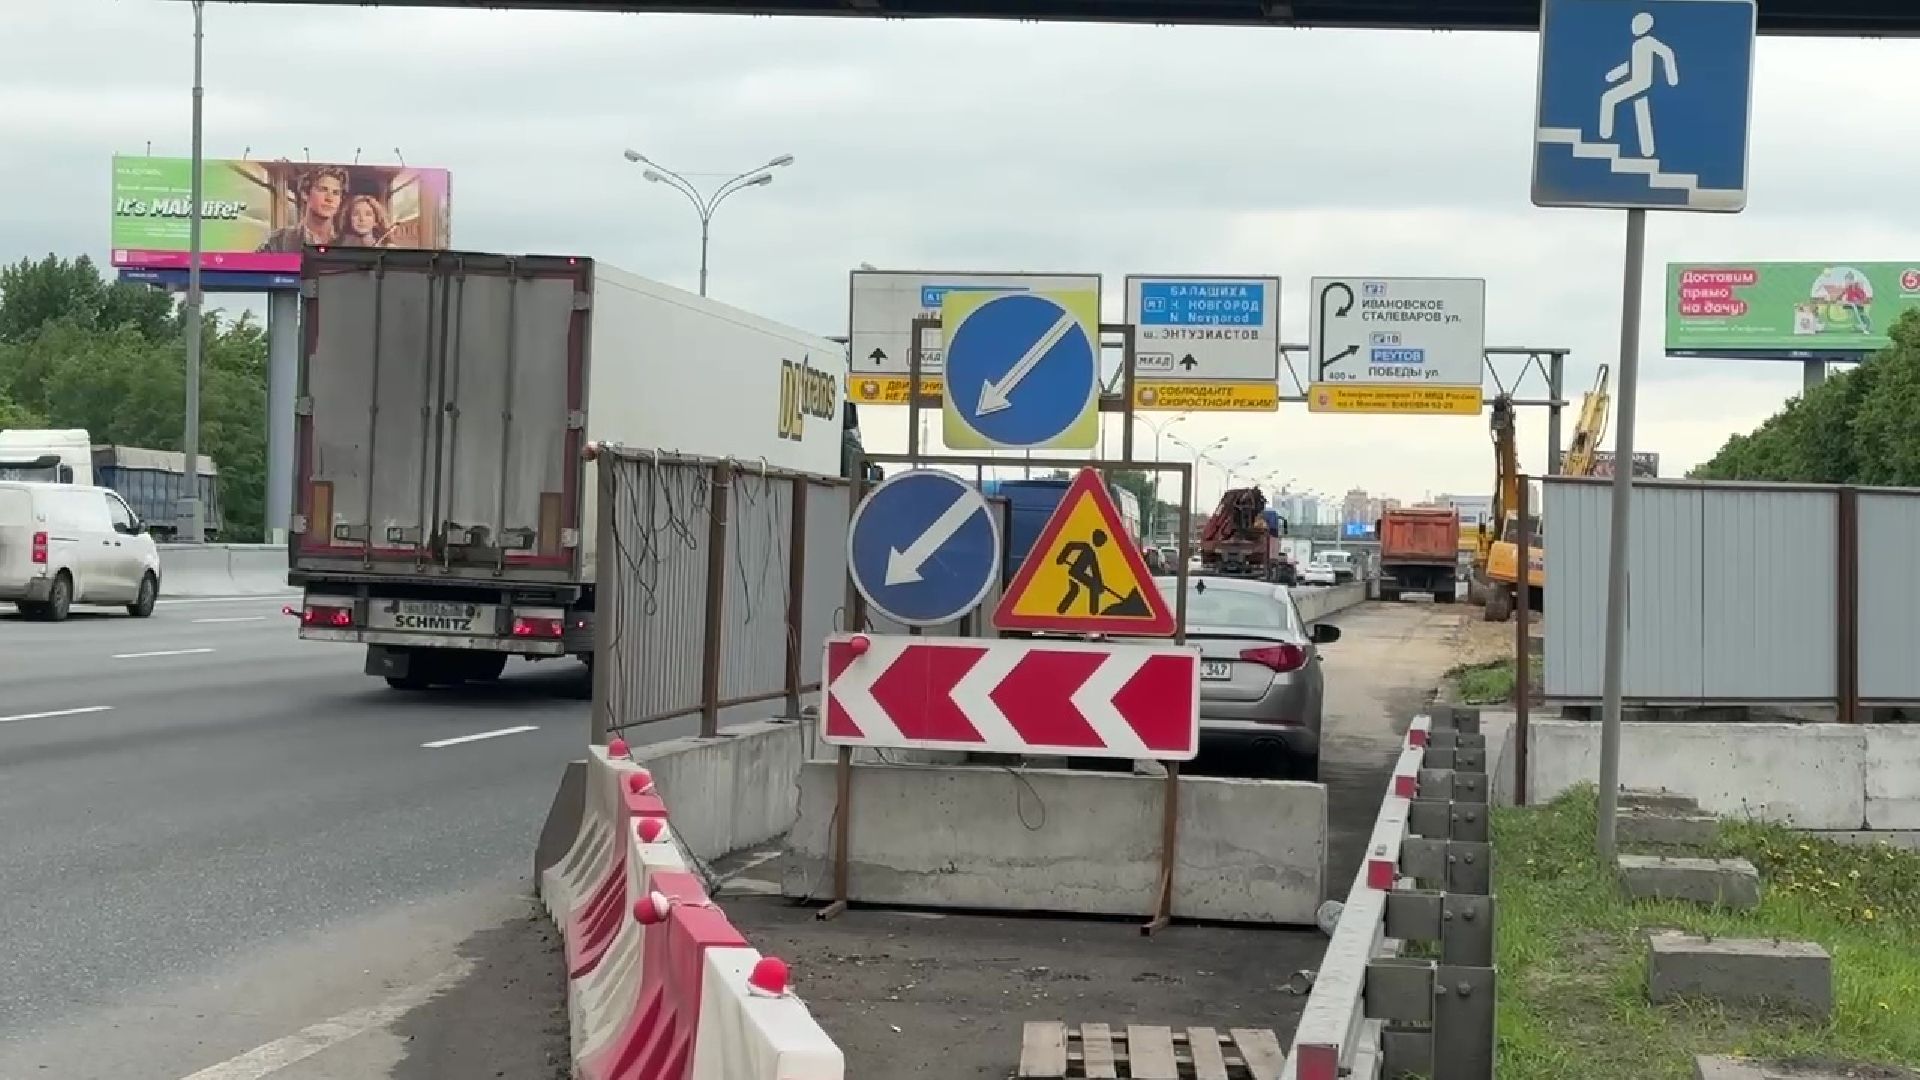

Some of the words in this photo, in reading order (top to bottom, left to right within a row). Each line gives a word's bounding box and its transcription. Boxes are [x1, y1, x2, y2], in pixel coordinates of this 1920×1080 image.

[1682, 271, 1753, 284] Доставим
[1170, 285, 1247, 296] БАЛАШИХА
[1682, 288, 1728, 300] прямо
[1188, 299, 1259, 312] НОВГОРОД
[1362, 299, 1444, 310] ИВАНОВСКОЕ
[1682, 303, 1700, 313] на
[1704, 302, 1744, 315] дачу!
[1188, 312, 1249, 325] Novgorod
[1362, 311, 1441, 322] СТАЛЕВАРОВ
[1161, 328, 1259, 340] ЭНТУЗИАСТОВ
[1138, 356, 1170, 366] МКАД
[1374, 351, 1421, 361] РЕУТОВ
[1369, 367, 1422, 377] ПОБЕДЫ
[395, 615, 472, 631] SCHMITZ
